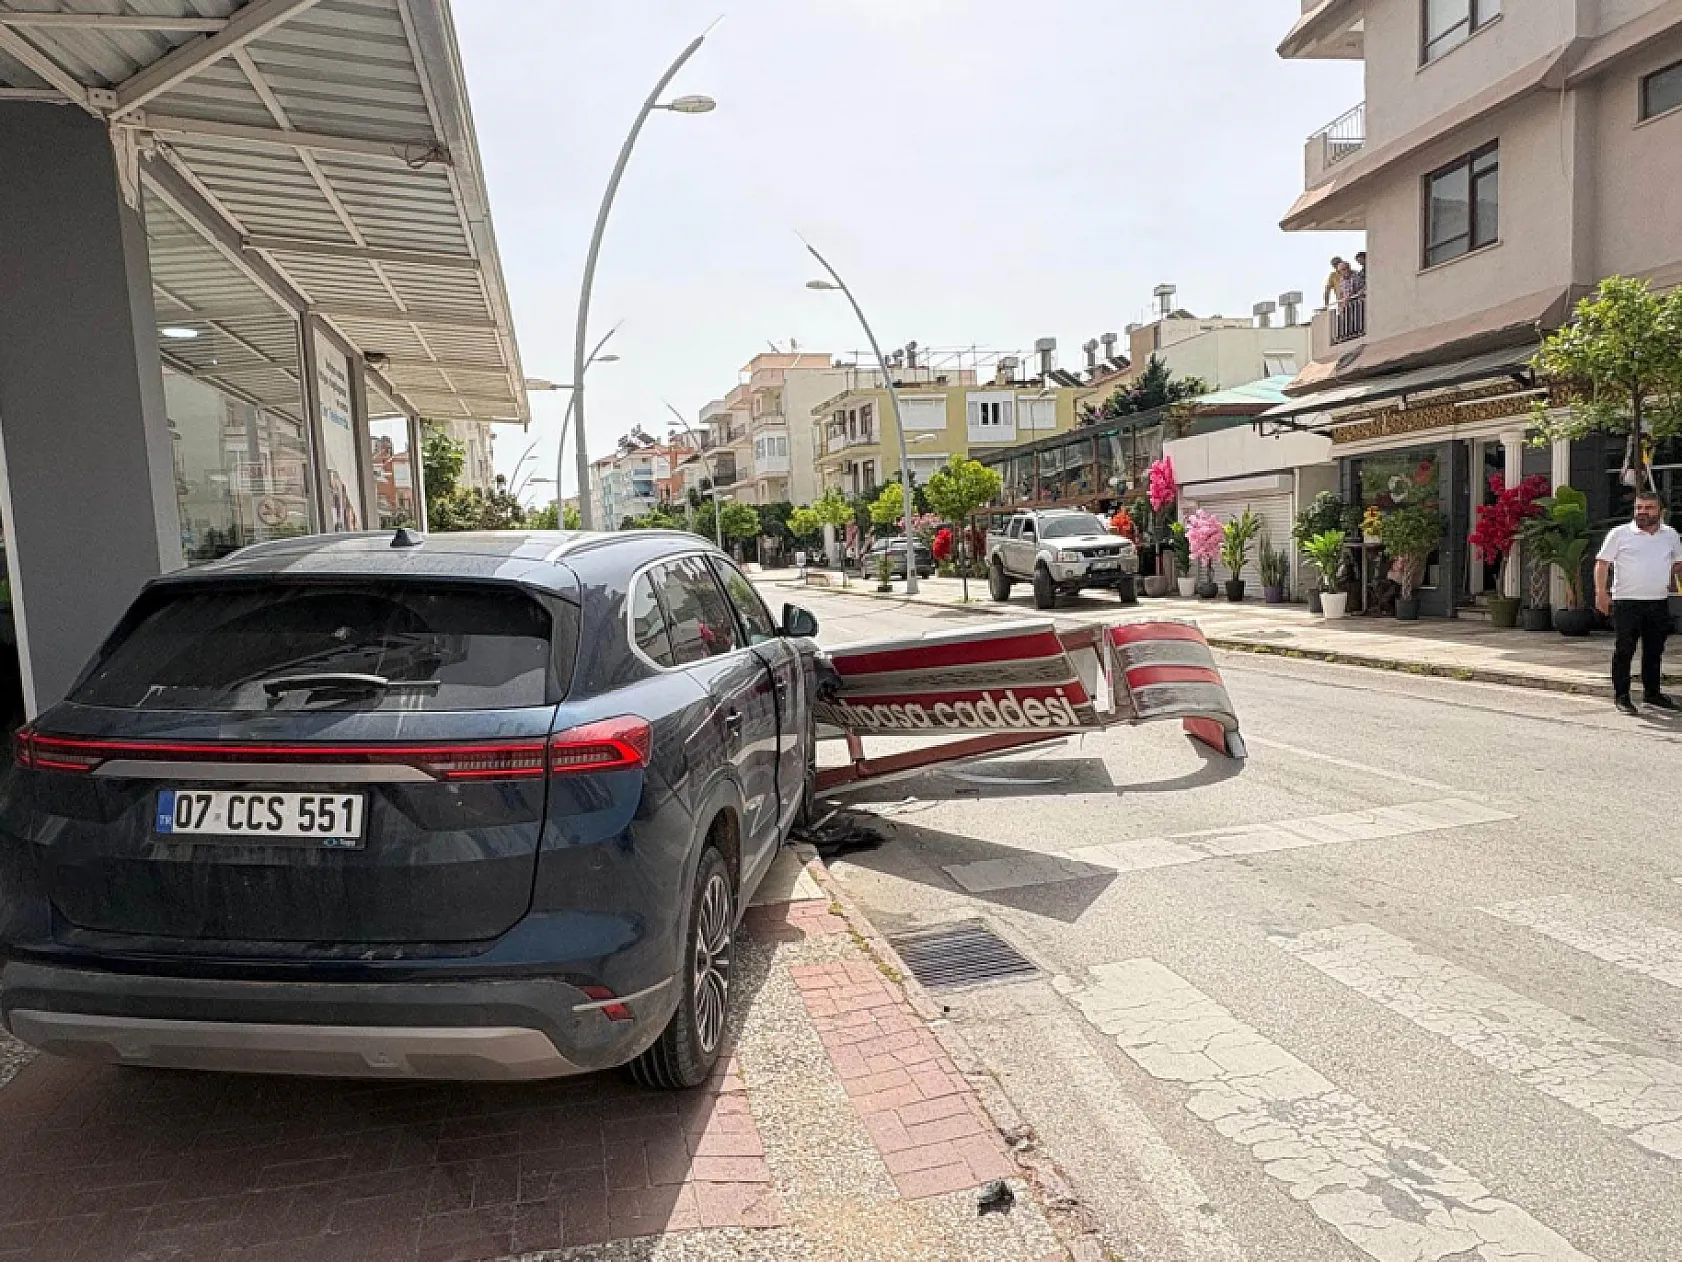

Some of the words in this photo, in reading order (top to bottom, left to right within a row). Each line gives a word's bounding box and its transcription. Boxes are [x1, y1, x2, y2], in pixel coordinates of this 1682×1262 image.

[934, 688, 1081, 728] caddesi
[176, 794, 213, 829] 07
[227, 795, 286, 831] CCS
[298, 796, 354, 833] 551
